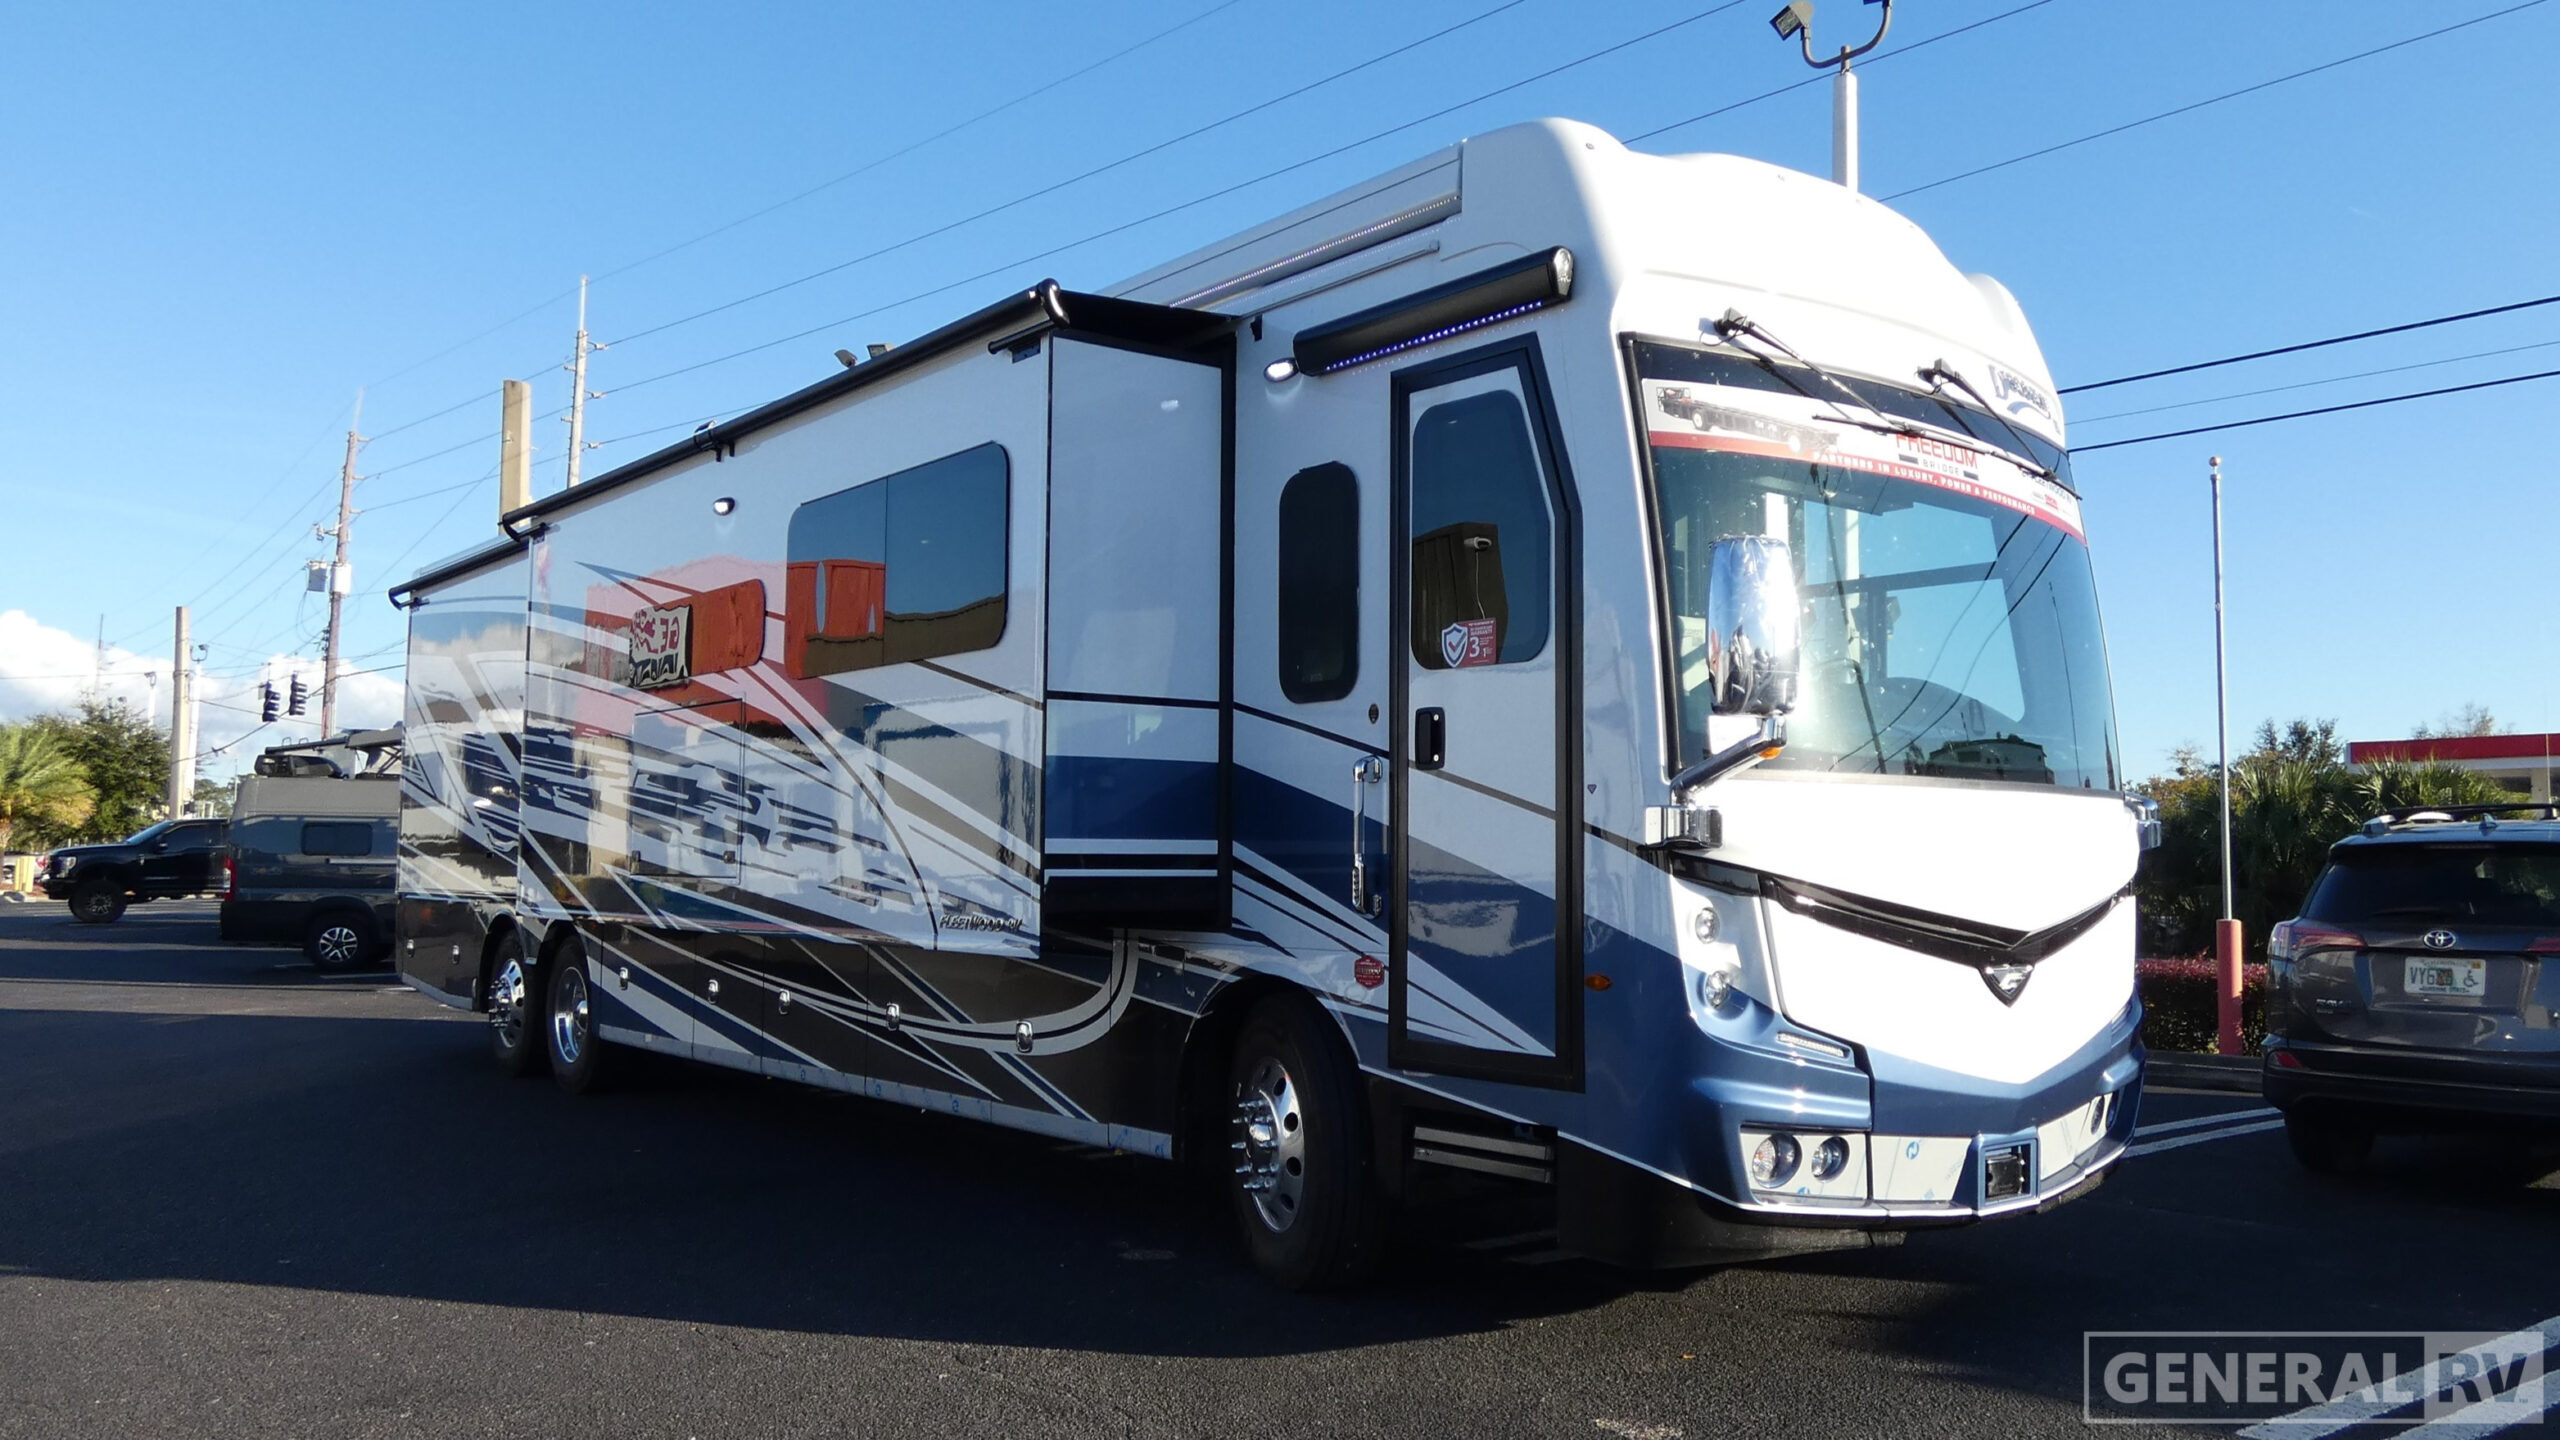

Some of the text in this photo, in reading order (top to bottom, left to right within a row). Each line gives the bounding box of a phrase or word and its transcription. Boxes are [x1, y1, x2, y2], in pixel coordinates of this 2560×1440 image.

[1896, 433, 1978, 469] FREEDOM
[1922, 458, 1961, 477] BRIDGE
[1813, 451, 1874, 470] PARTNERS
[1878, 462, 1891, 473] IN
[1895, 466, 1938, 485] LUXURY,
[1941, 477, 1972, 493] POWER
[1983, 488, 2036, 515] PERFORMANCE
[940, 914, 1004, 932] FLEETWOOD
